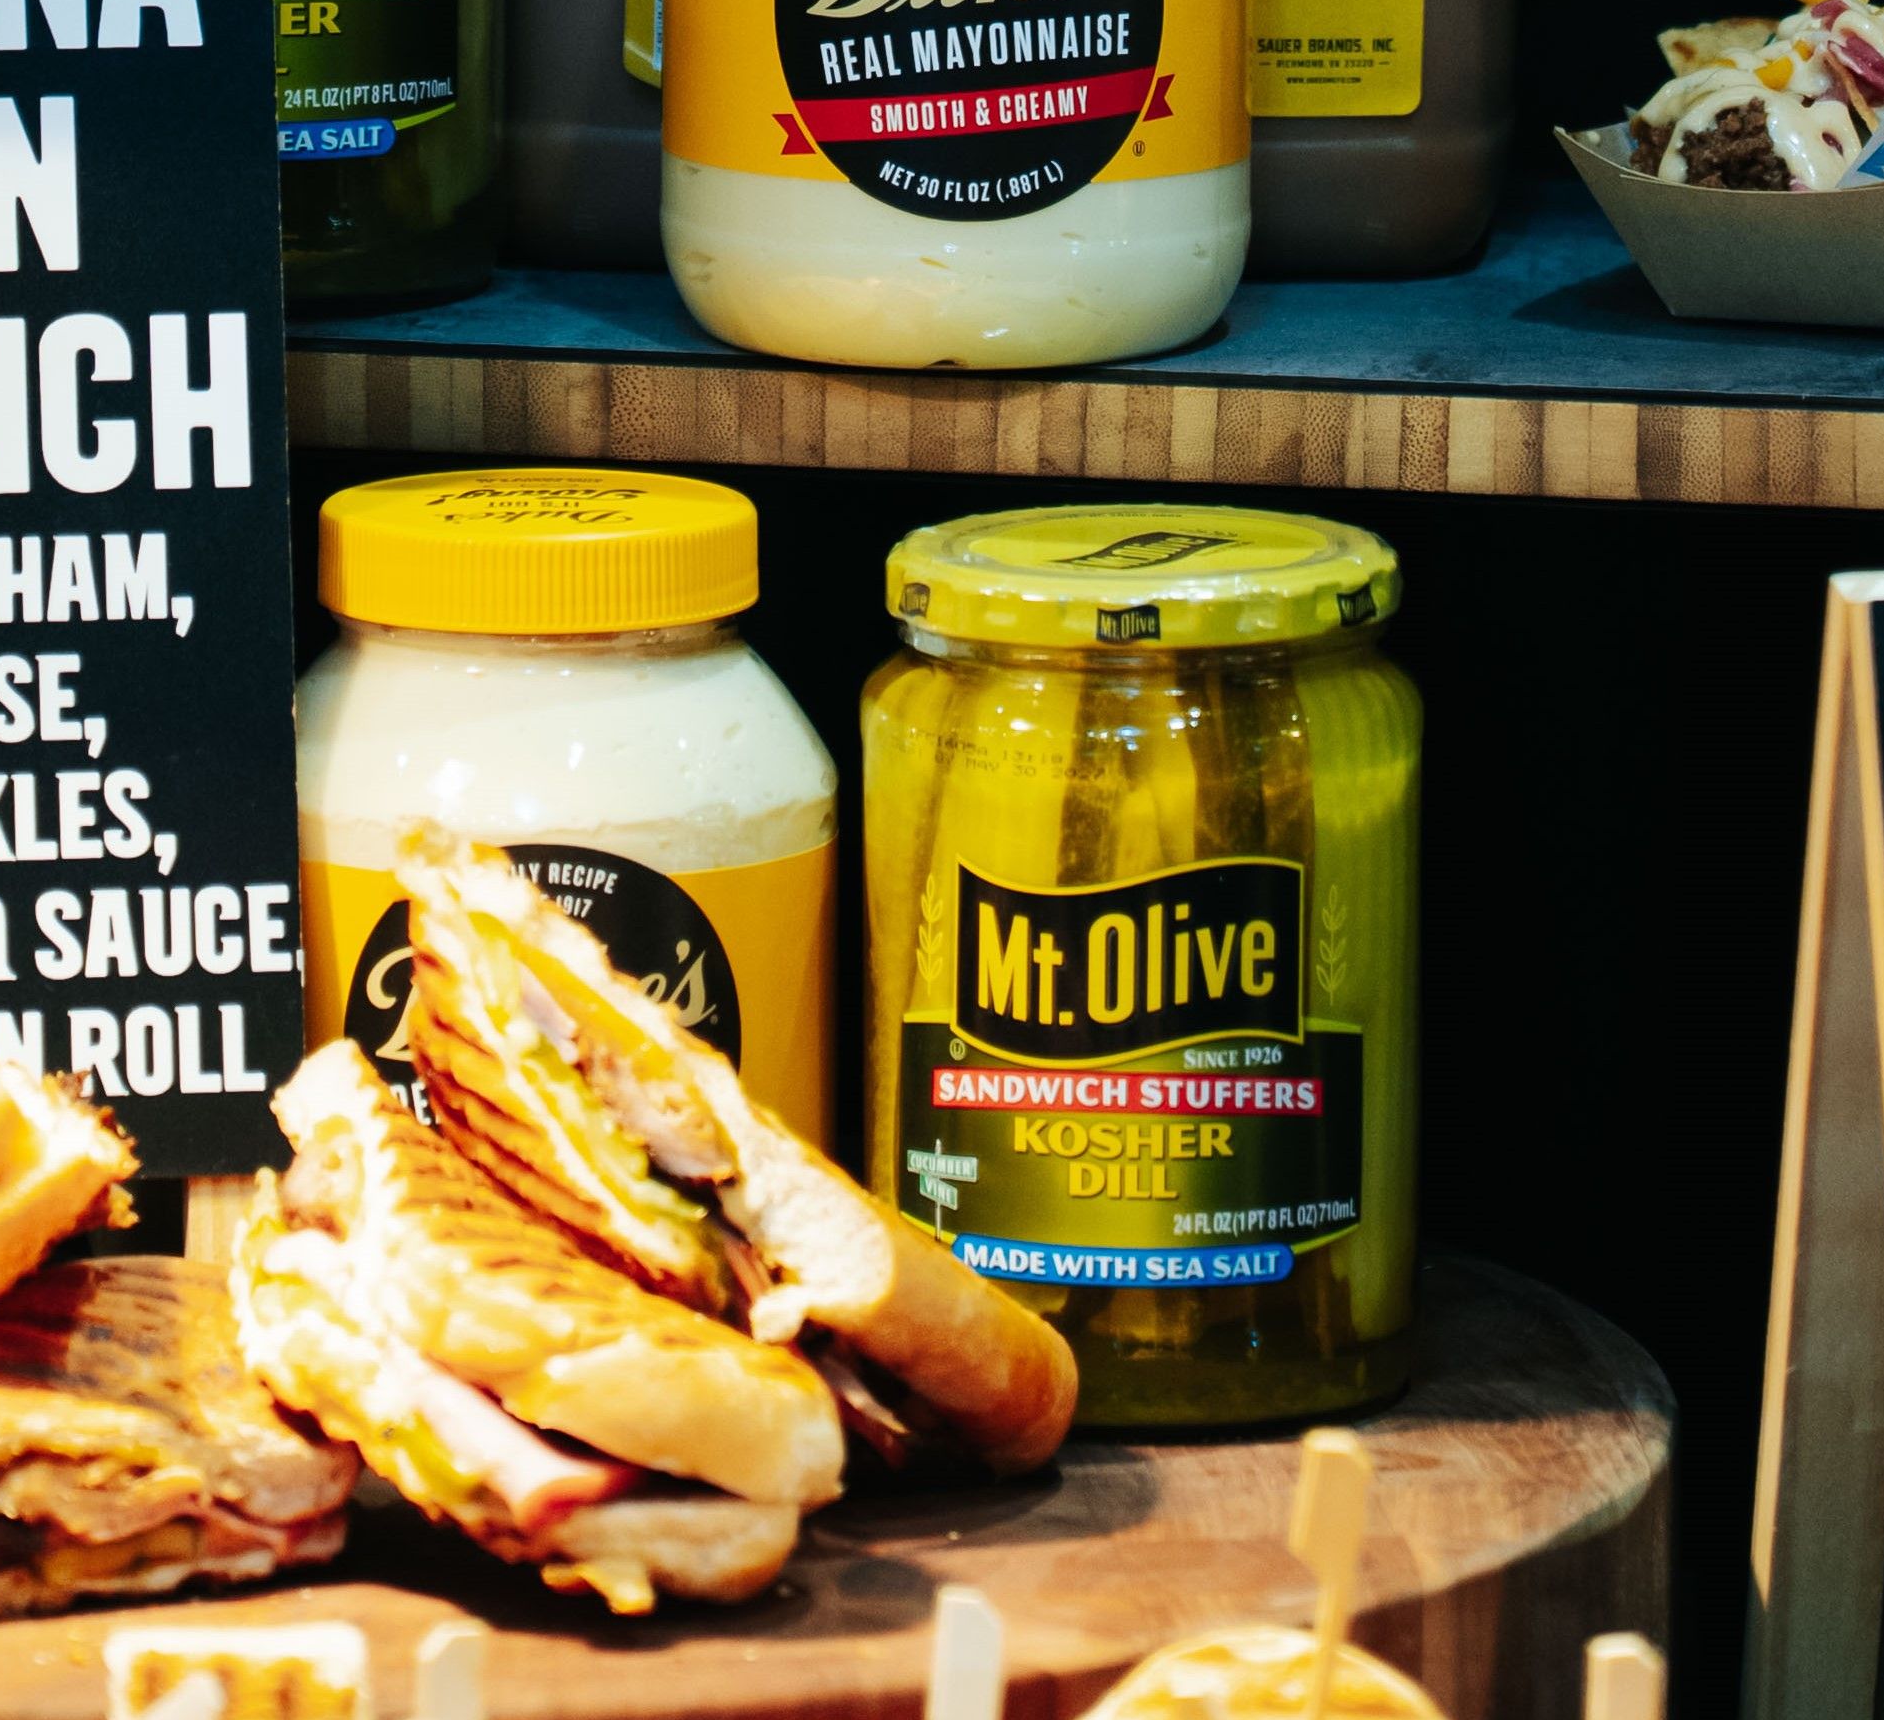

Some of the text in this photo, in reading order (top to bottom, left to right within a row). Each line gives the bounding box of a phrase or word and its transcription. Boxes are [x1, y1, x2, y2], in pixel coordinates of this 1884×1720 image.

[820, 12, 1130, 85] REAL MAYONNAISE
[1257, 38, 1301, 53] SAUER
[284, 89, 301, 109] 24
[304, 87, 320, 107] FL
[353, 85, 370, 106] PT
[372, 84, 379, 104] 8
[382, 82, 396, 103] FL
[870, 86, 1089, 134] SMOOTH & CREAMY
[321, 125, 383, 150] SALT
[879, 160, 1064, 203] NET 30 FL OZ (.887 L)
[1100, 611, 1156, 639] Mt. Olive
[548, 862, 618, 894] RECIPE
[978, 901, 1275, 1027] Mt. Olive
[67, 1002, 266, 1098] ROLL
[1183, 1045, 1282, 1070] SINCE 1926
[938, 1072, 1316, 1110] SANDWICH STUFFERS
[1014, 1116, 1234, 1159] KOSHER
[1068, 1162, 1178, 1199] DILL
[1173, 1213, 1191, 1236] 24
[1194, 1212, 1211, 1234] FL
[1247, 1209, 1265, 1230] PT
[1268, 1209, 1278, 1230] 8
[1279, 1206, 1294, 1228] FL
[963, 1243, 1281, 1280] MADE WITH SEA SALT
